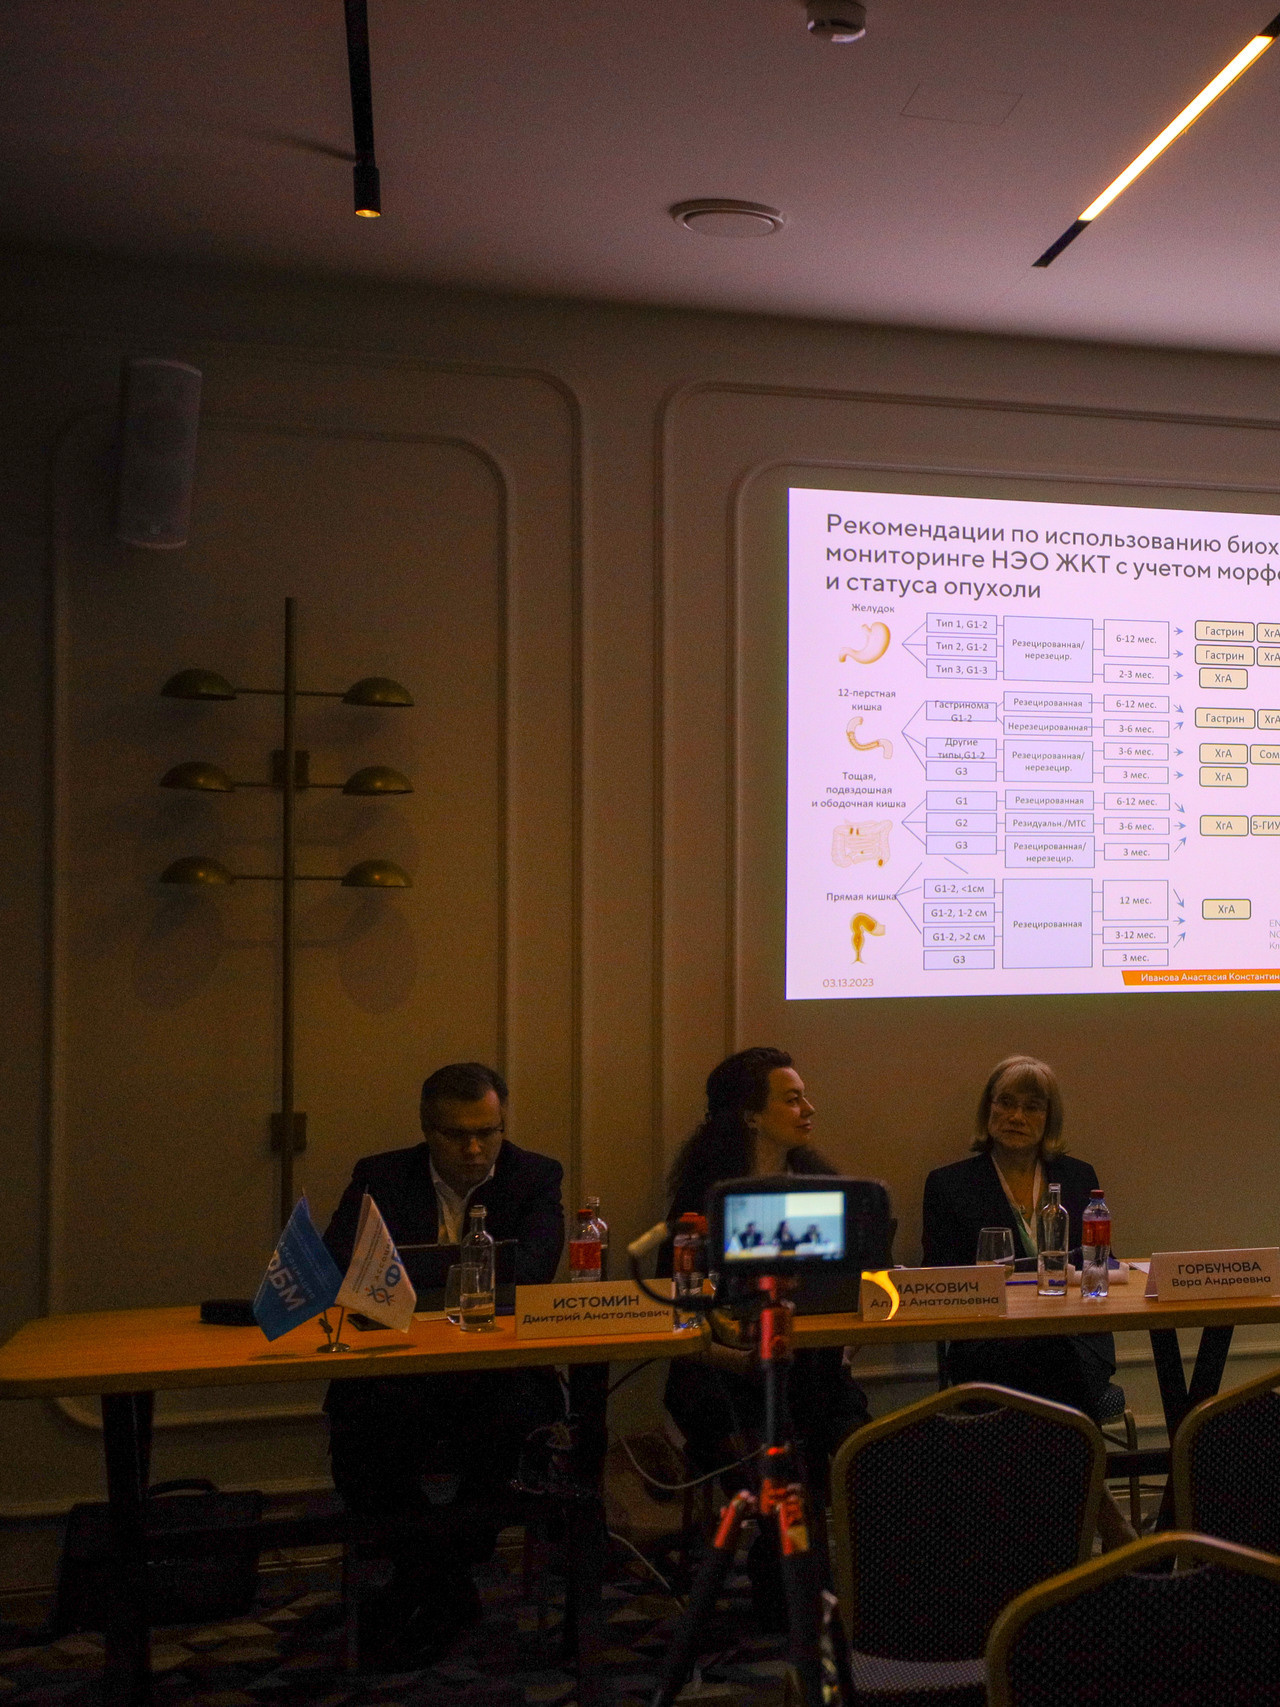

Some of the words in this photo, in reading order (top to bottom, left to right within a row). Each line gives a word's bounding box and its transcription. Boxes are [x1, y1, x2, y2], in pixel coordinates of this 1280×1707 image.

[827, 514, 1005, 543] Рекомендации
[1012, 529, 1039, 543] по
[1045, 530, 1221, 553] использованию
[826, 546, 985, 569] мониторинге
[992, 551, 1049, 571] НЭО
[1056, 553, 1109, 574] ЖКТ
[1116, 561, 1127, 574] с
[1134, 562, 1212, 580] учетом
[826, 576, 840, 590] и
[846, 577, 937, 597] статуса
[944, 580, 1041, 599] опухоли
[852, 603, 895, 614] Желудок
[936, 619, 953, 630] Тип
[956, 619, 963, 630] 1,
[966, 619, 988, 630] G1-2
[1205, 626, 1245, 638] Гастрин
[1265, 628, 1280, 639] ХгА
[1116, 633, 1134, 643] 6-12
[1137, 636, 1157, 644] мес.
[936, 641, 953, 652] Тип
[956, 641, 963, 652] 2,
[966, 641, 988, 652] G1-2
[1012, 639, 1085, 651] Резецированная/
[1025, 651, 1072, 662] нерезецир.
[1205, 650, 1245, 662] Гастрин
[1265, 652, 1280, 663] ХгА
[936, 664, 953, 675] Тип
[956, 664, 963, 675] 3,
[966, 664, 988, 675] G1-3
[1119, 670, 1133, 679] 2-3
[1135, 671, 1154, 679] мес.
[1215, 673, 1232, 685] ХгА
[838, 689, 896, 699] 12-перстная
[852, 702, 882, 711] кишка
[935, 700, 989, 710] Гастринома
[1014, 697, 1083, 708] Резецированная
[1116, 699, 1134, 709] 6-12
[1137, 701, 1157, 710] мес.
[951, 714, 972, 722] G1-2
[1205, 713, 1245, 725] Гастрин
[1008, 721, 1088, 733] Нерезецированная
[1119, 723, 1133, 733] 3-6
[1135, 725, 1154, 734] мес.
[945, 738, 978, 747] Другие
[1012, 751, 1085, 763] Резецированная/
[1119, 747, 1133, 756] 3-6
[1135, 749, 1154, 757] мес.
[1215, 748, 1232, 760] ХгА
[955, 766, 968, 777] G3
[1025, 763, 1072, 773] нерезецир.
[842, 771, 876, 782] Тощая,
[1123, 771, 1128, 779] 3
[1131, 772, 1150, 780] мес.
[1215, 771, 1232, 783] ХгА
[826, 785, 893, 796] подвздошная
[820, 798, 873, 810] ободочная
[876, 800, 906, 809] кишка
[955, 796, 968, 806] G1
[1015, 795, 1084, 806] Резецированная
[1117, 797, 1135, 807] 6-12
[1138, 798, 1157, 807] мес.
[955, 817, 968, 828] G2
[1012, 818, 1086, 829] Резидуальн./МТС
[1119, 821, 1133, 831] 3-6
[1136, 823, 1154, 832] мес.
[1216, 820, 1233, 832] ХгА
[955, 840, 968, 850] G3
[1014, 842, 1086, 853] Резецированная/
[1123, 848, 1129, 856] 3
[1131, 849, 1150, 857] мес.
[1026, 854, 1074, 864] нерезецир.
[934, 883, 958, 896] G1-2,
[827, 892, 862, 903] Прямая
[865, 893, 897, 901] кишка
[1120, 896, 1130, 905] 12
[1133, 897, 1152, 905] мес.
[931, 908, 955, 920] G1-2,
[958, 909, 973, 918] 1-2
[1218, 903, 1235, 915] ХгА
[1013, 919, 1082, 930] Резецированная
[933, 932, 957, 943] G1-2,
[960, 932, 971, 941] >2
[1115, 930, 1134, 939] 3-12
[1136, 932, 1156, 940] мес.
[953, 955, 966, 965] G3
[1122, 953, 1128, 962] 3
[823, 978, 874, 988] 03.13.2023
[1141, 973, 1179, 982] Иванова
[1181, 973, 1227, 981] Анастасия
[1178, 1260, 1261, 1275] ГОРБУНОВА
[1172, 1276, 1198, 1289] Вера
[1200, 1274, 1271, 1288] Андреевна
[554, 1295, 639, 1309] ИСТОМИН
[871, 1299, 905, 1308] Ала
[910, 1296, 999, 1307] Анатольевна
[523, 1311, 579, 1325] Дмитрий
[583, 1308, 669, 1321] Анатольевич
